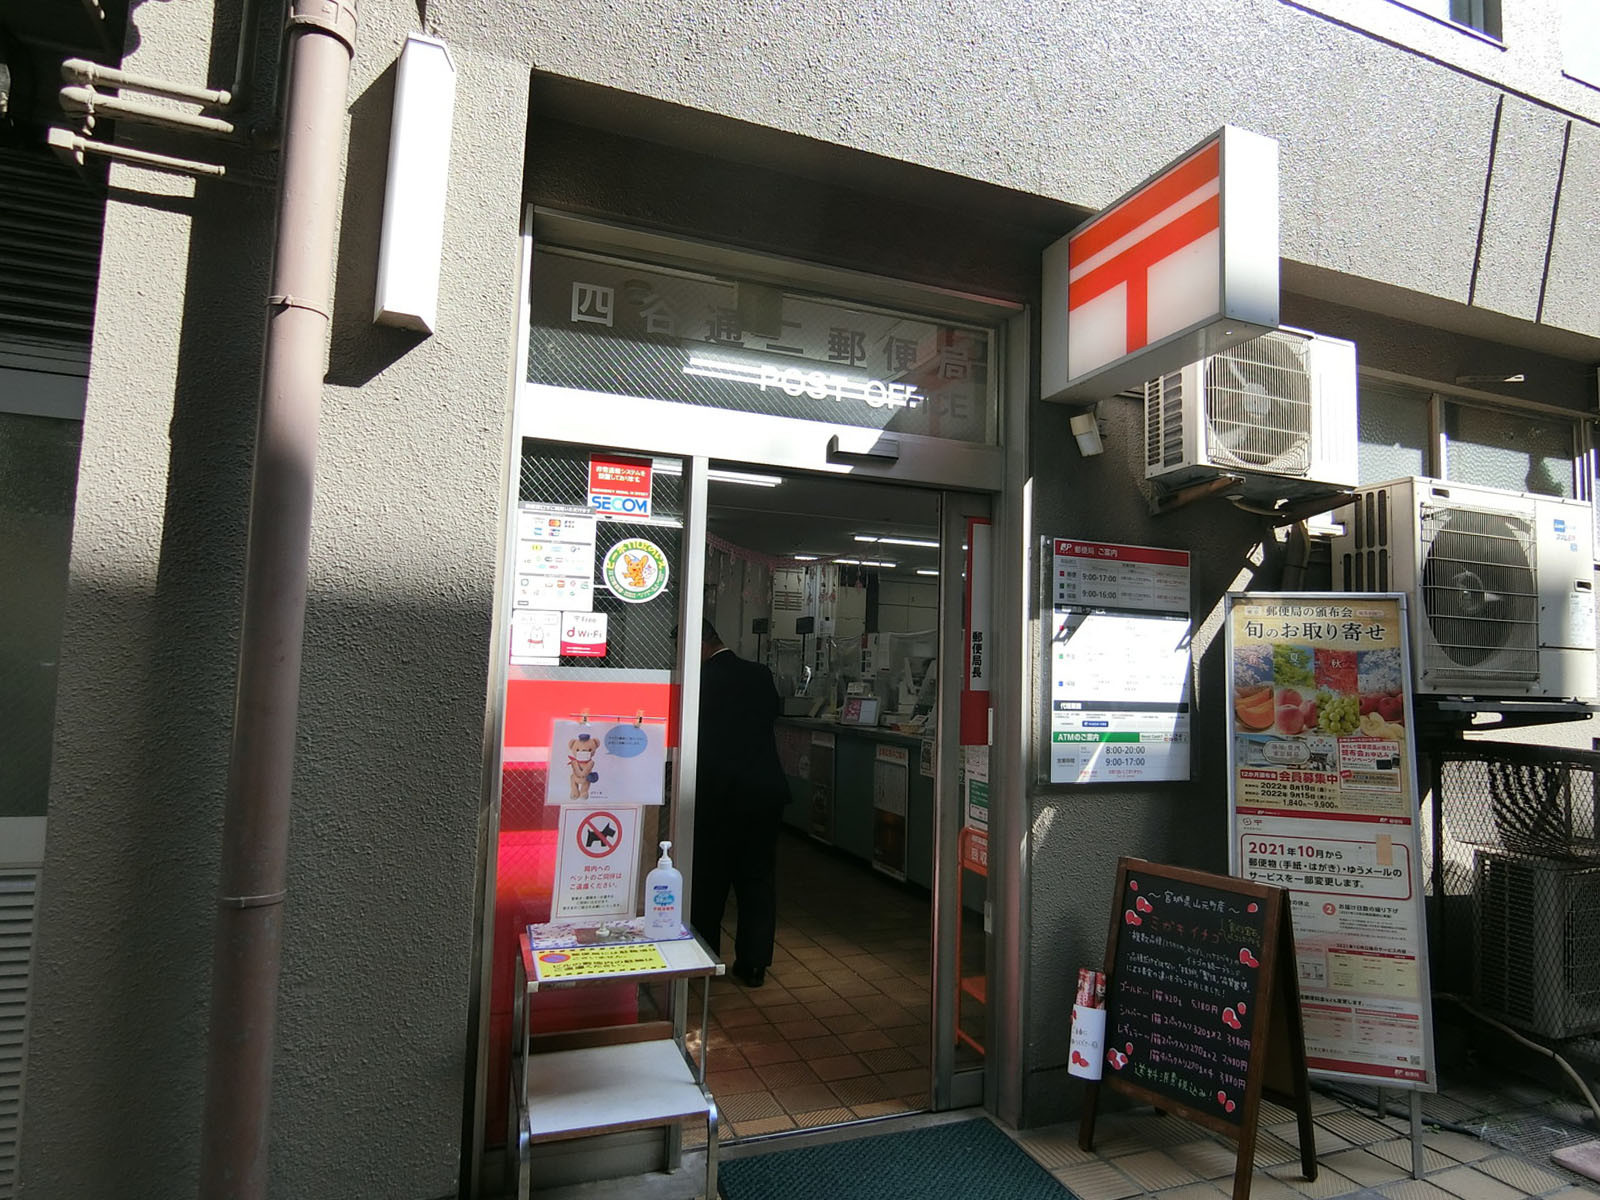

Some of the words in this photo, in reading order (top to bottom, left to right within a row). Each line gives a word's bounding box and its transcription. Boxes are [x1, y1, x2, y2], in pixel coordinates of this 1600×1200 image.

[760, 365, 847, 402] POST
[592, 496, 648, 513] SECOM
[1074, 545, 1095, 555] 郵便局
[1098, 548, 1118, 558] ご案内
[1082, 573, 1117, 582] 9:00-17:00
[1266, 606, 1353, 618] 郵便局の頒布会
[1245, 620, 1386, 642] 旬のお取り寄せ
[971, 631, 983, 678] 郵便局長
[1331, 658, 1343, 669] 秋
[1057, 733, 1100, 742] ATMのご案内
[1105, 746, 1146, 755] 8:00-20:00
[1105, 757, 1146, 766] 9:00-17:00
[1279, 771, 1338, 785] 会員募集中
[1248, 842, 1343, 859] 2021年10月から
[1248, 871, 1365, 889] サービスを一部変更します。
[1338, 903, 1399, 914] お届け日数の繰り下げ
